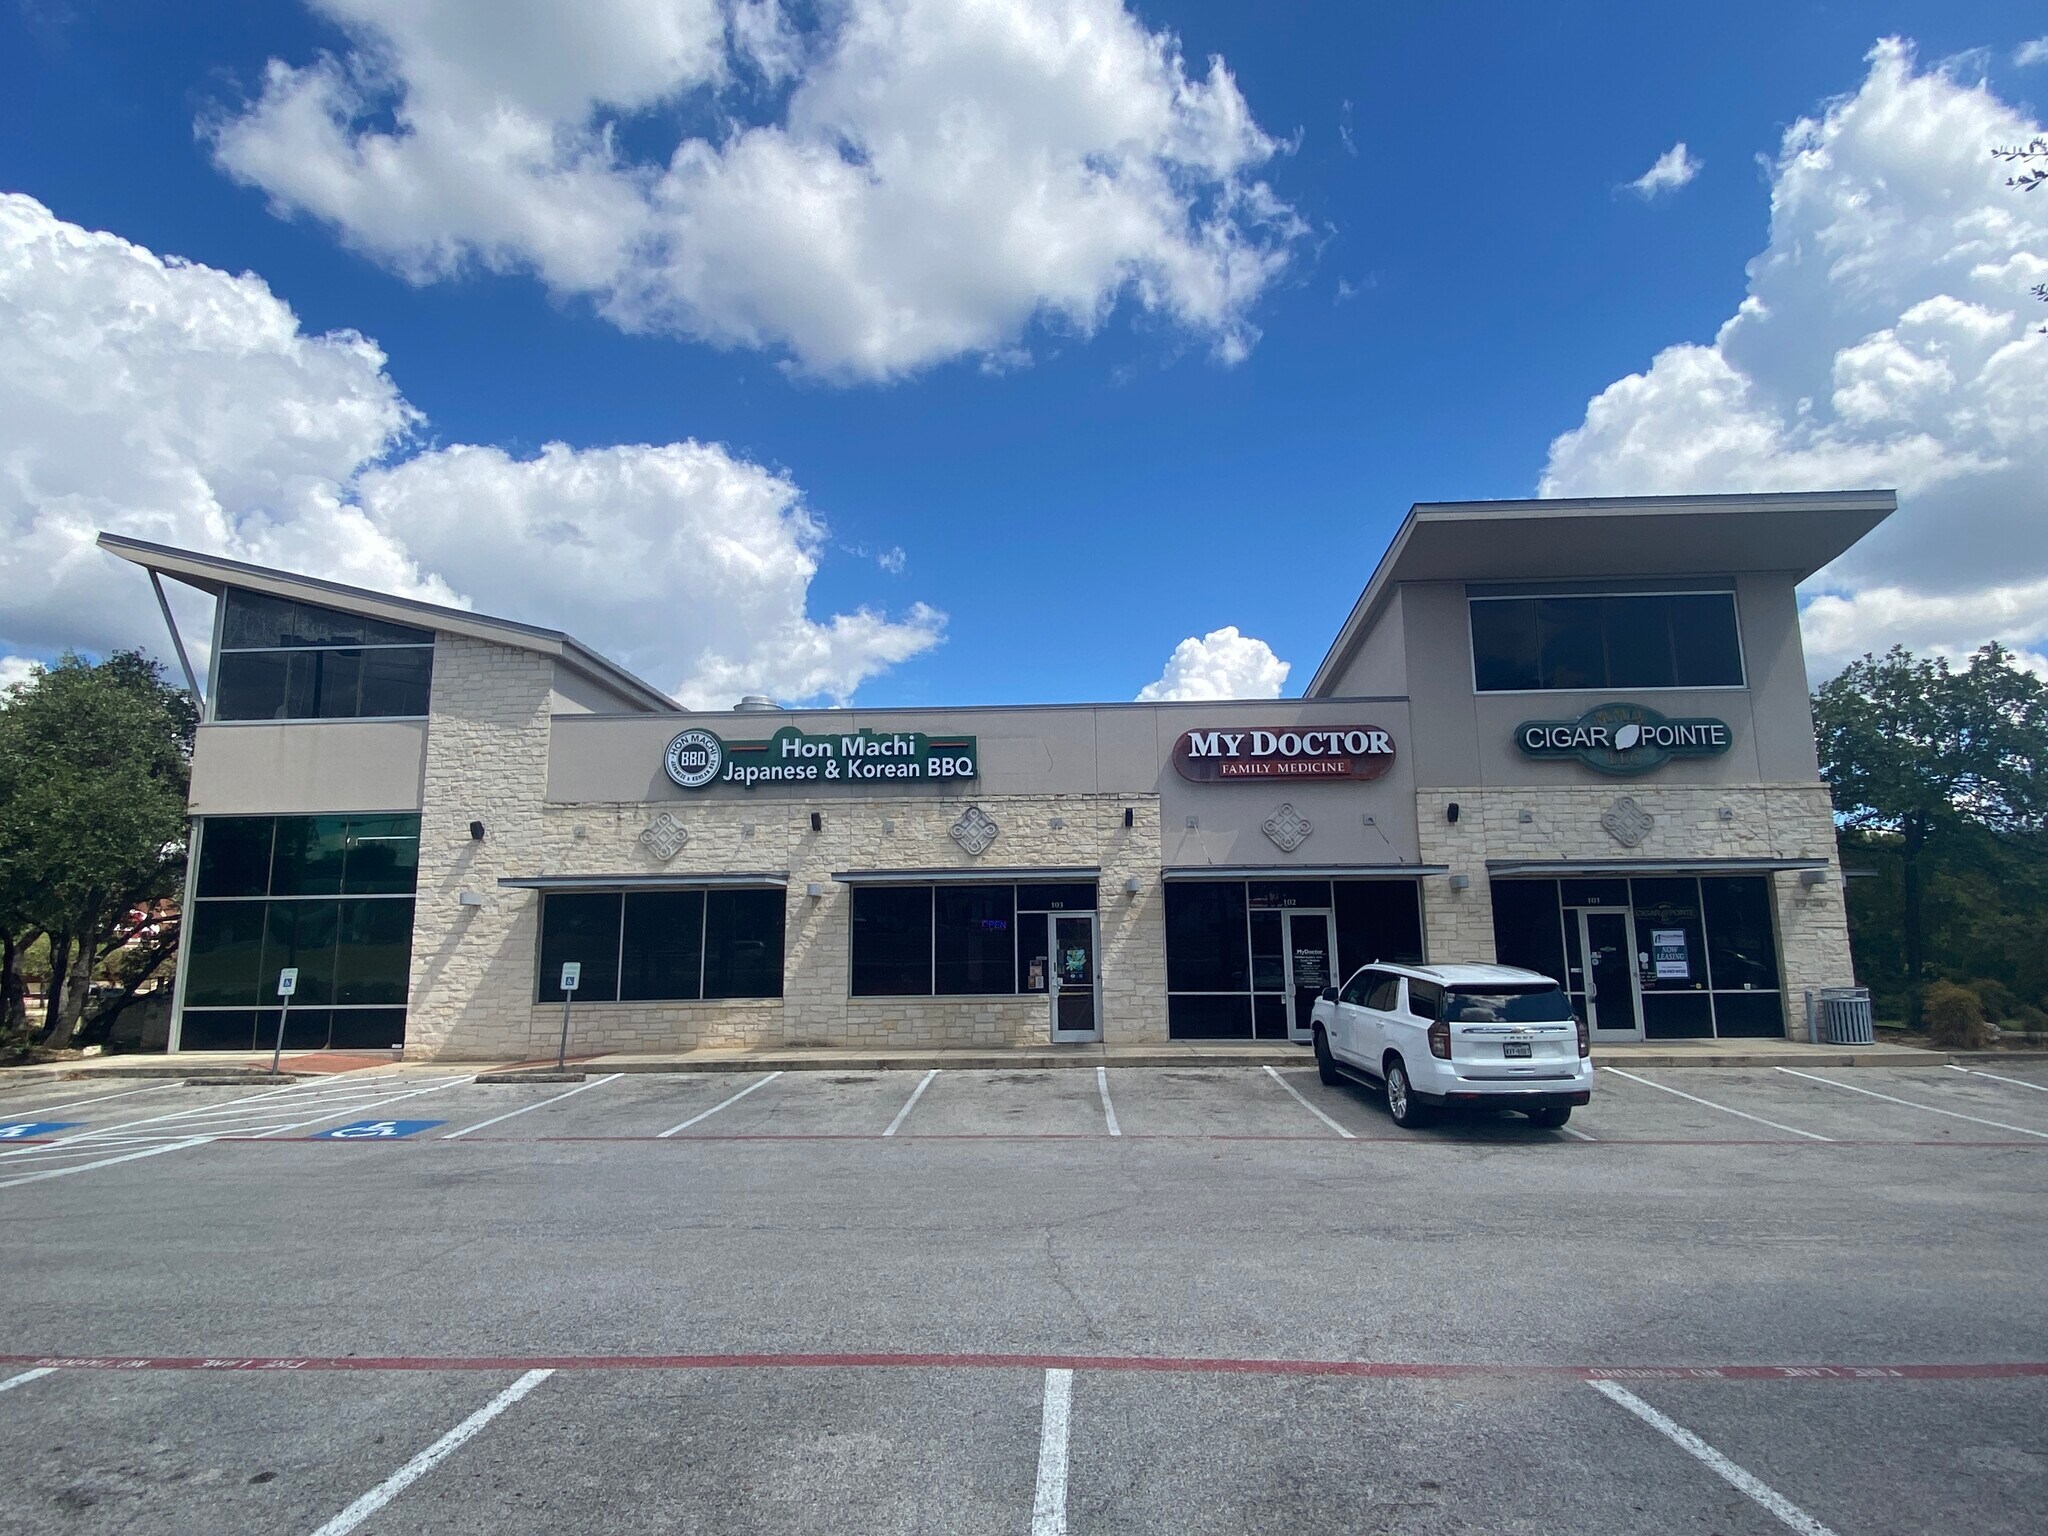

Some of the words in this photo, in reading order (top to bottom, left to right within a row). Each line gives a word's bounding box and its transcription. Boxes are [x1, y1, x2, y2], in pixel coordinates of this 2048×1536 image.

[670, 736, 689, 755] HON
[691, 734, 718, 755] MACHI
[782, 737, 831, 758] Hon
[841, 735, 915, 757] Machi
[1188, 732, 1245, 757] MY
[1250, 730, 1394, 757] DOCTOR
[1526, 727, 1609, 748] CIGAR
[1641, 725, 1726, 746] POINTE
[681, 751, 706, 766] BBQ
[1222, 763, 1271, 774] FAMILY
[1277, 762, 1345, 774] MEDICINE
[723, 761, 817, 785] Japanese
[825, 760, 840, 779] &
[848, 757, 921, 778] Korean
[927, 757, 974, 777] BBQ
[981, 919, 1006, 929] OPEN
[1656, 953, 1685, 961] LEASING
